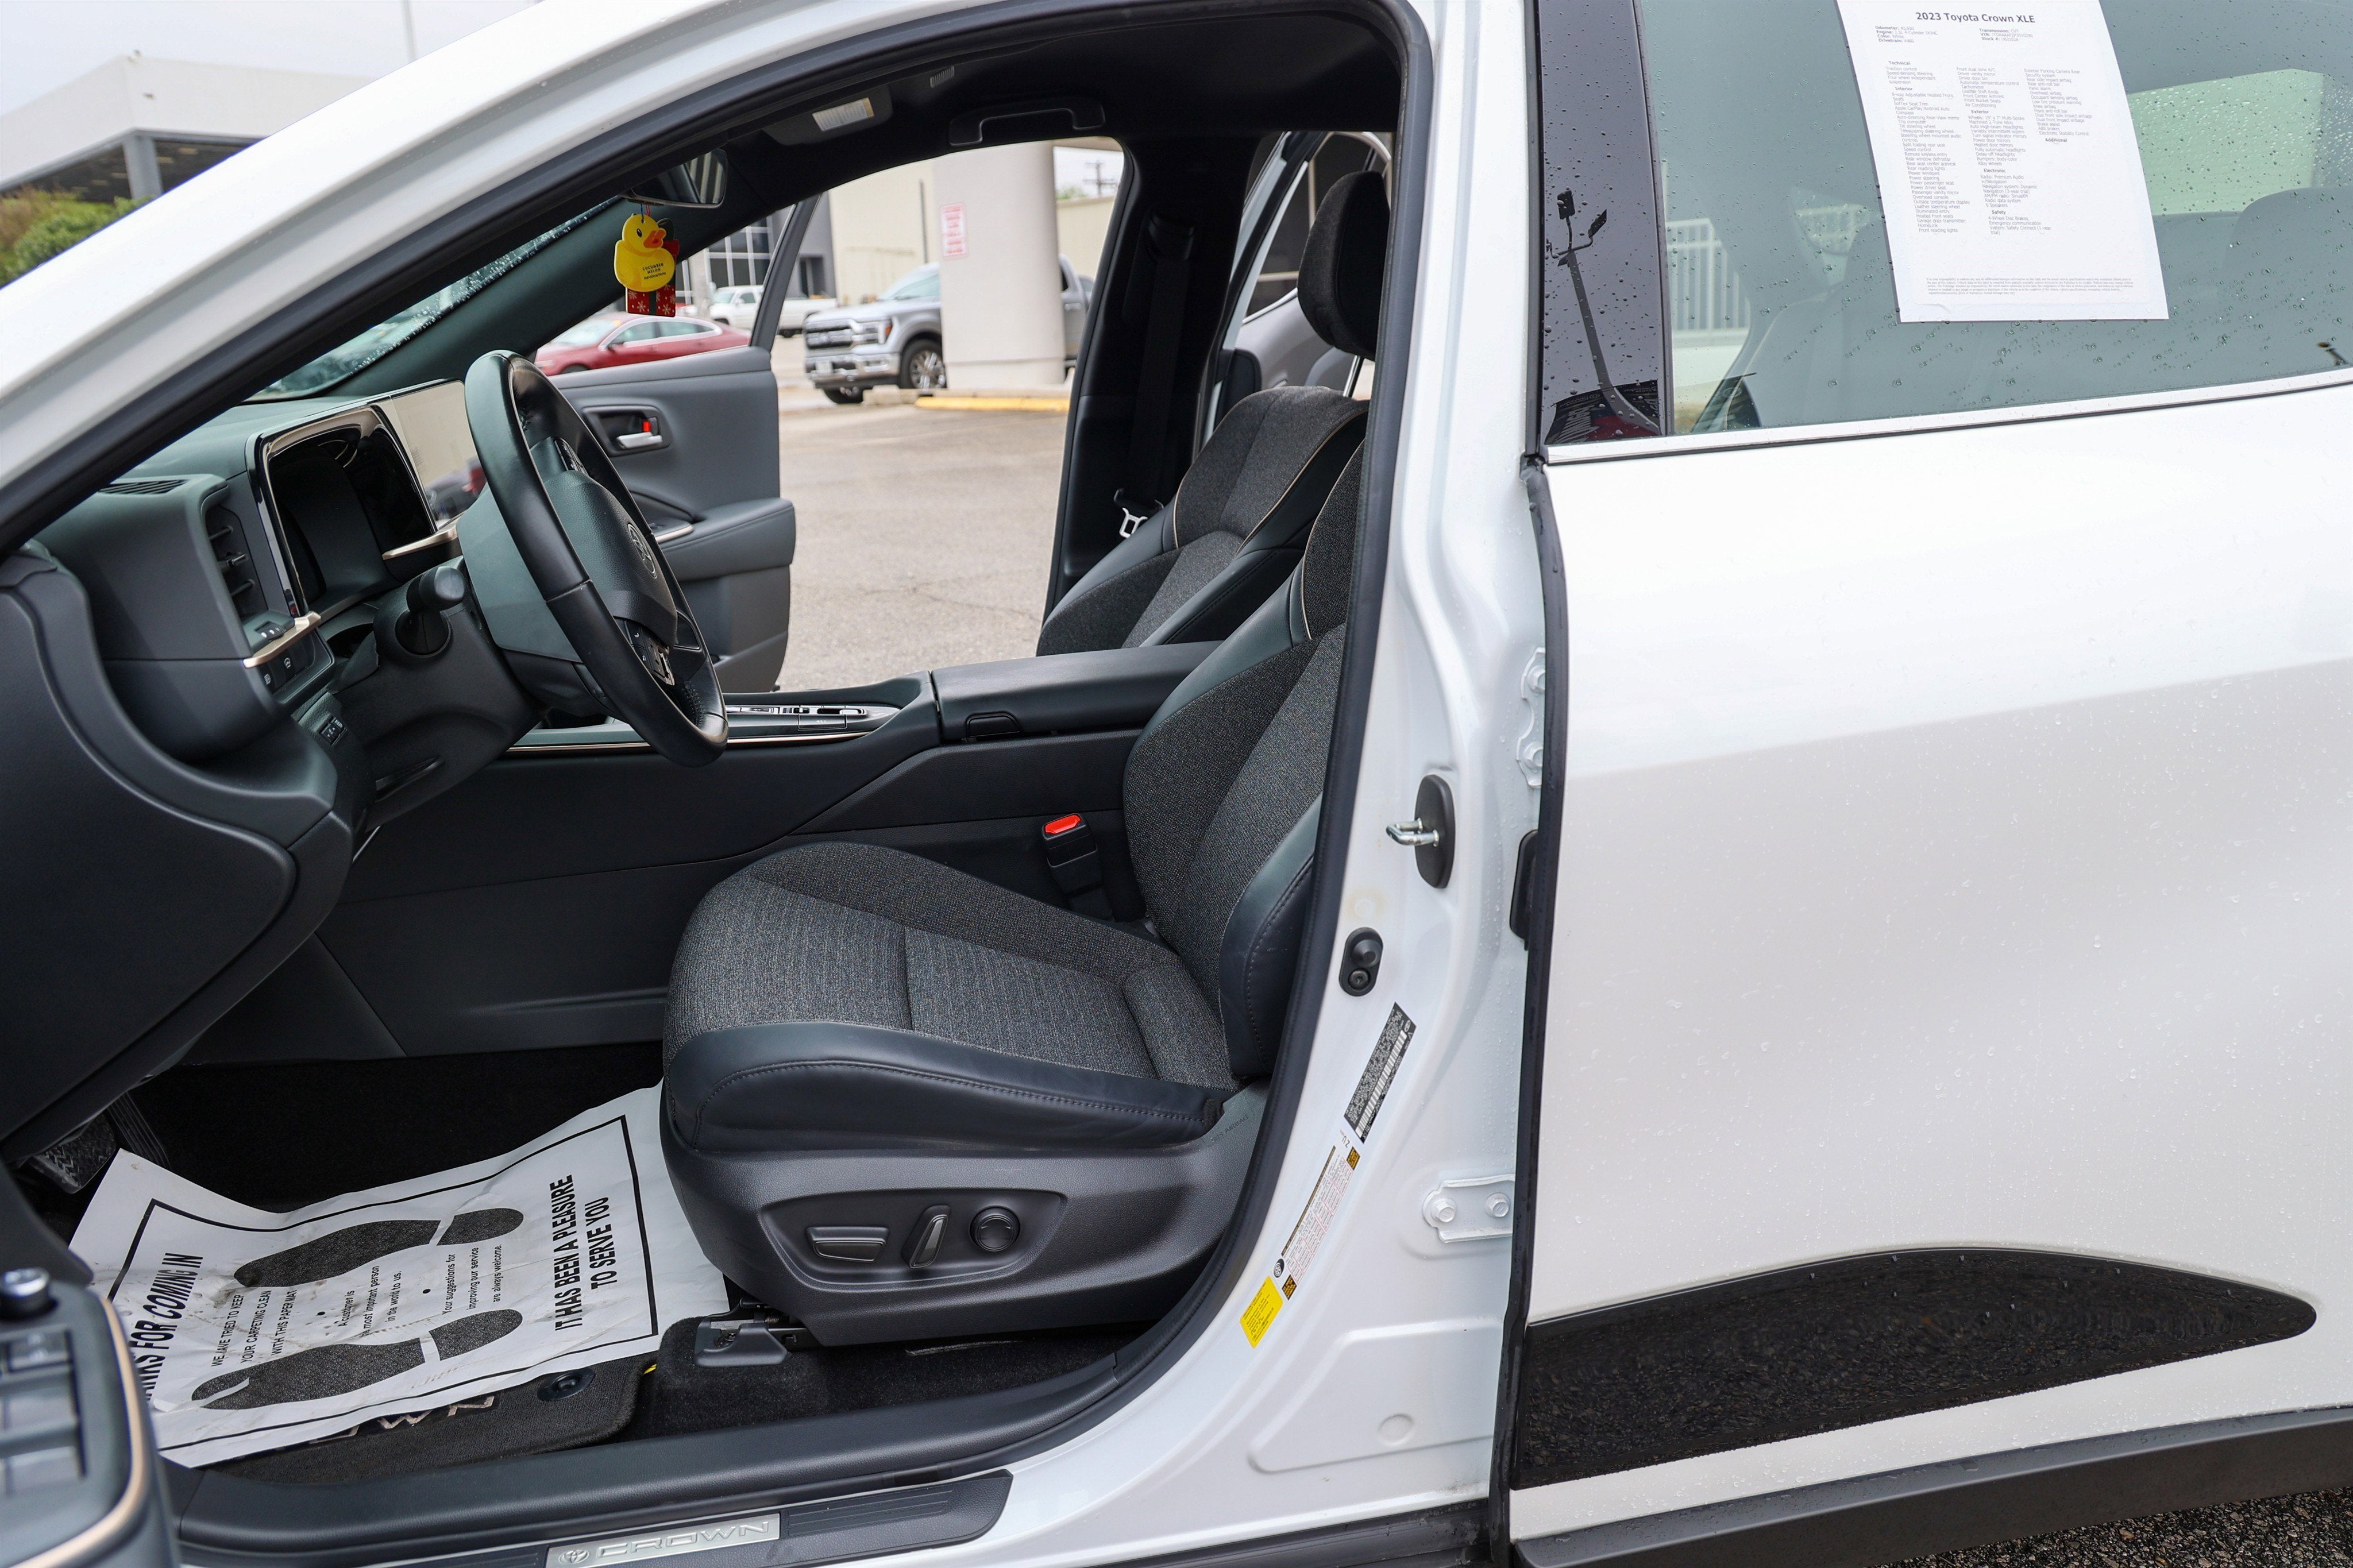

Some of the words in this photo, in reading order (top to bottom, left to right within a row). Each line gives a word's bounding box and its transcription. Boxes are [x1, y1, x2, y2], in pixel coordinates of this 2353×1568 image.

[1916, 12, 1941, 20] 2023
[1943, 13, 1979, 22] Toyota
[1981, 14, 2014, 22] Crown
[2016, 15, 2035, 23] XLE
[642, 262, 664, 271] CUCUMBER
[1225, 1115, 1248, 1133] AIRBAG
[550, 1175, 577, 1241] PLEASURE
[585, 1197, 610, 1227] YOU
[554, 1239, 578, 1252] A
[587, 1224, 616, 1269] SERVE
[161, 1253, 203, 1268] IN
[446, 1254, 455, 1262] for
[469, 1248, 479, 1269] service
[492, 1245, 502, 1272] welcome.
[371, 1266, 380, 1287] person
[394, 1271, 402, 1281] us.
[554, 1253, 580, 1288] BEEN
[591, 1270, 618, 1289] TO
[445, 1264, 456, 1300] suggestions
[492, 1273, 503, 1292] always
[143, 1270, 198, 1319] COMING
[230, 1295, 244, 1310] KEEP
[257, 1291, 272, 1309] CLEAN
[284, 1290, 297, 1303] MAT
[363, 1288, 377, 1312] important
[389, 1290, 400, 1306] world
[466, 1281, 480, 1310] improving
[554, 1288, 583, 1318] HAS
[227, 1311, 239, 1319] TO
[279, 1303, 294, 1320] PAPER
[341, 1297, 353, 1321] customer
[387, 1307, 397, 1315] the
[442, 1301, 453, 1315] Your
[221, 1320, 236, 1338] TRIED
[246, 1310, 265, 1343] CARPETING
[275, 1322, 288, 1336] THIS
[363, 1314, 373, 1328] most
[555, 1318, 583, 1331] IT
[129, 1320, 178, 1349] FOR
[241, 1345, 256, 1363] YOUR
[271, 1337, 284, 1355] WITH
[211, 1355, 225, 1366] WE
[596, 1521, 770, 1559] CROWN
